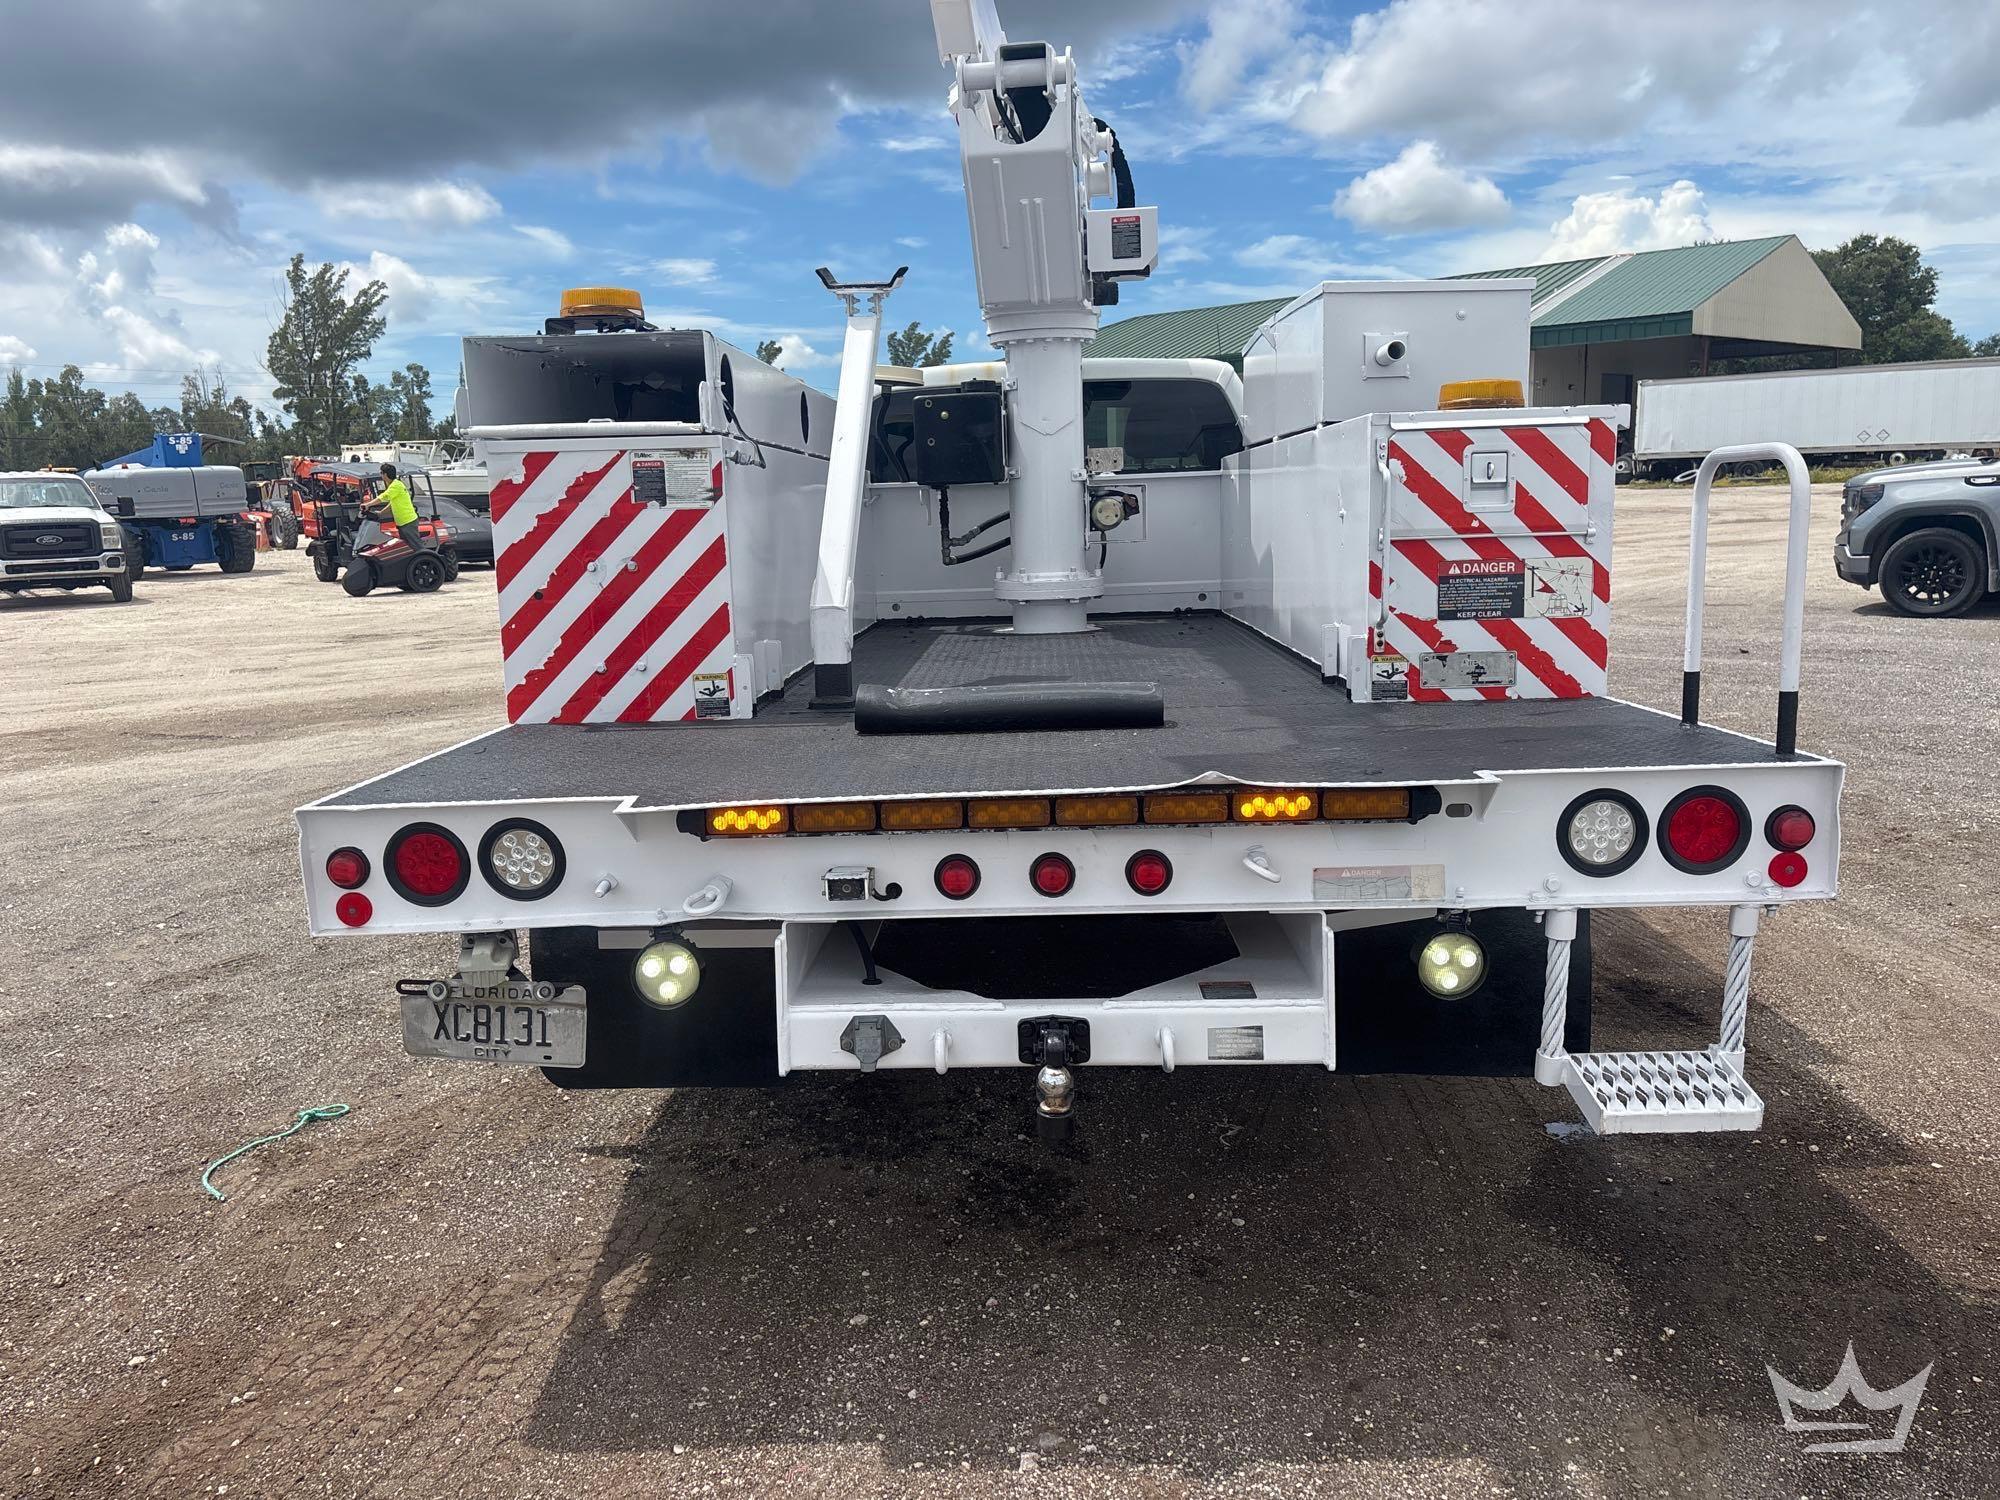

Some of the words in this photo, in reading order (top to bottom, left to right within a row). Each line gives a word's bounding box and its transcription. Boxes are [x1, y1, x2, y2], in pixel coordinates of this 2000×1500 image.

[168, 436, 193, 445] S-85
[171, 532, 195, 542] S-85
[1462, 562, 1516, 574] DANGER
[1477, 610, 1502, 618] CLEAR
[449, 986, 533, 999] FLORIDA
[433, 1002, 553, 1047] XC8131
[474, 1047, 513, 1059] CITY
